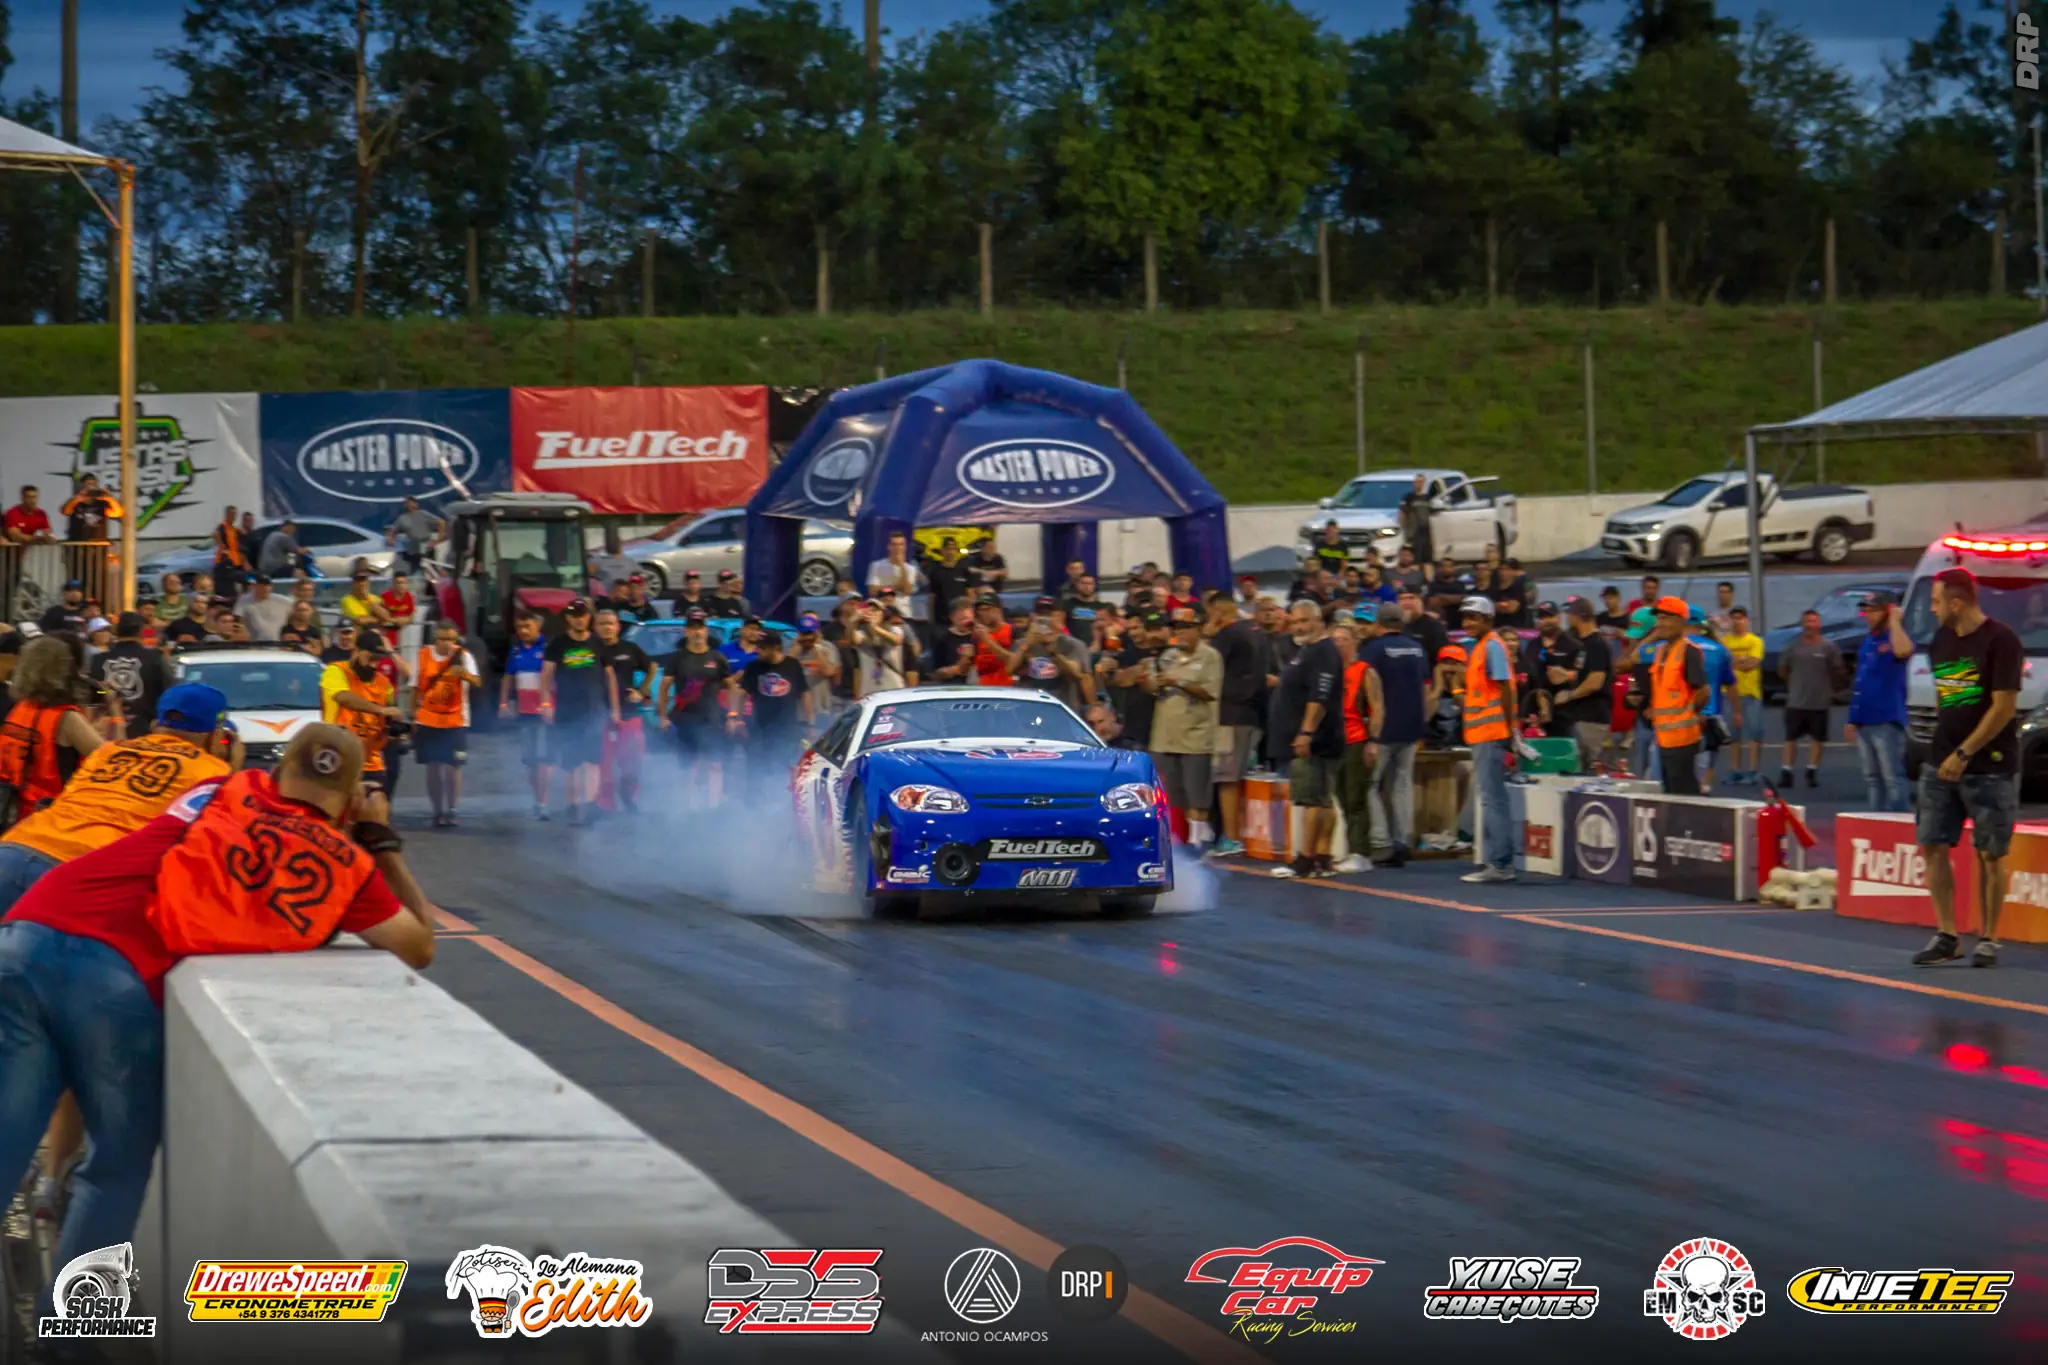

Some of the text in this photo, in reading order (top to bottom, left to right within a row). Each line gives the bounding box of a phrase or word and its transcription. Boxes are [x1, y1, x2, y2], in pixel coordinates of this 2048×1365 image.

[311, 434, 391, 472] MASTER
[534, 430, 750, 461] FuelTech
[969, 449, 1102, 482] MASTER POWER
[988, 839, 1096, 856] FuelTech
[1851, 838, 1928, 887] FuelTe
